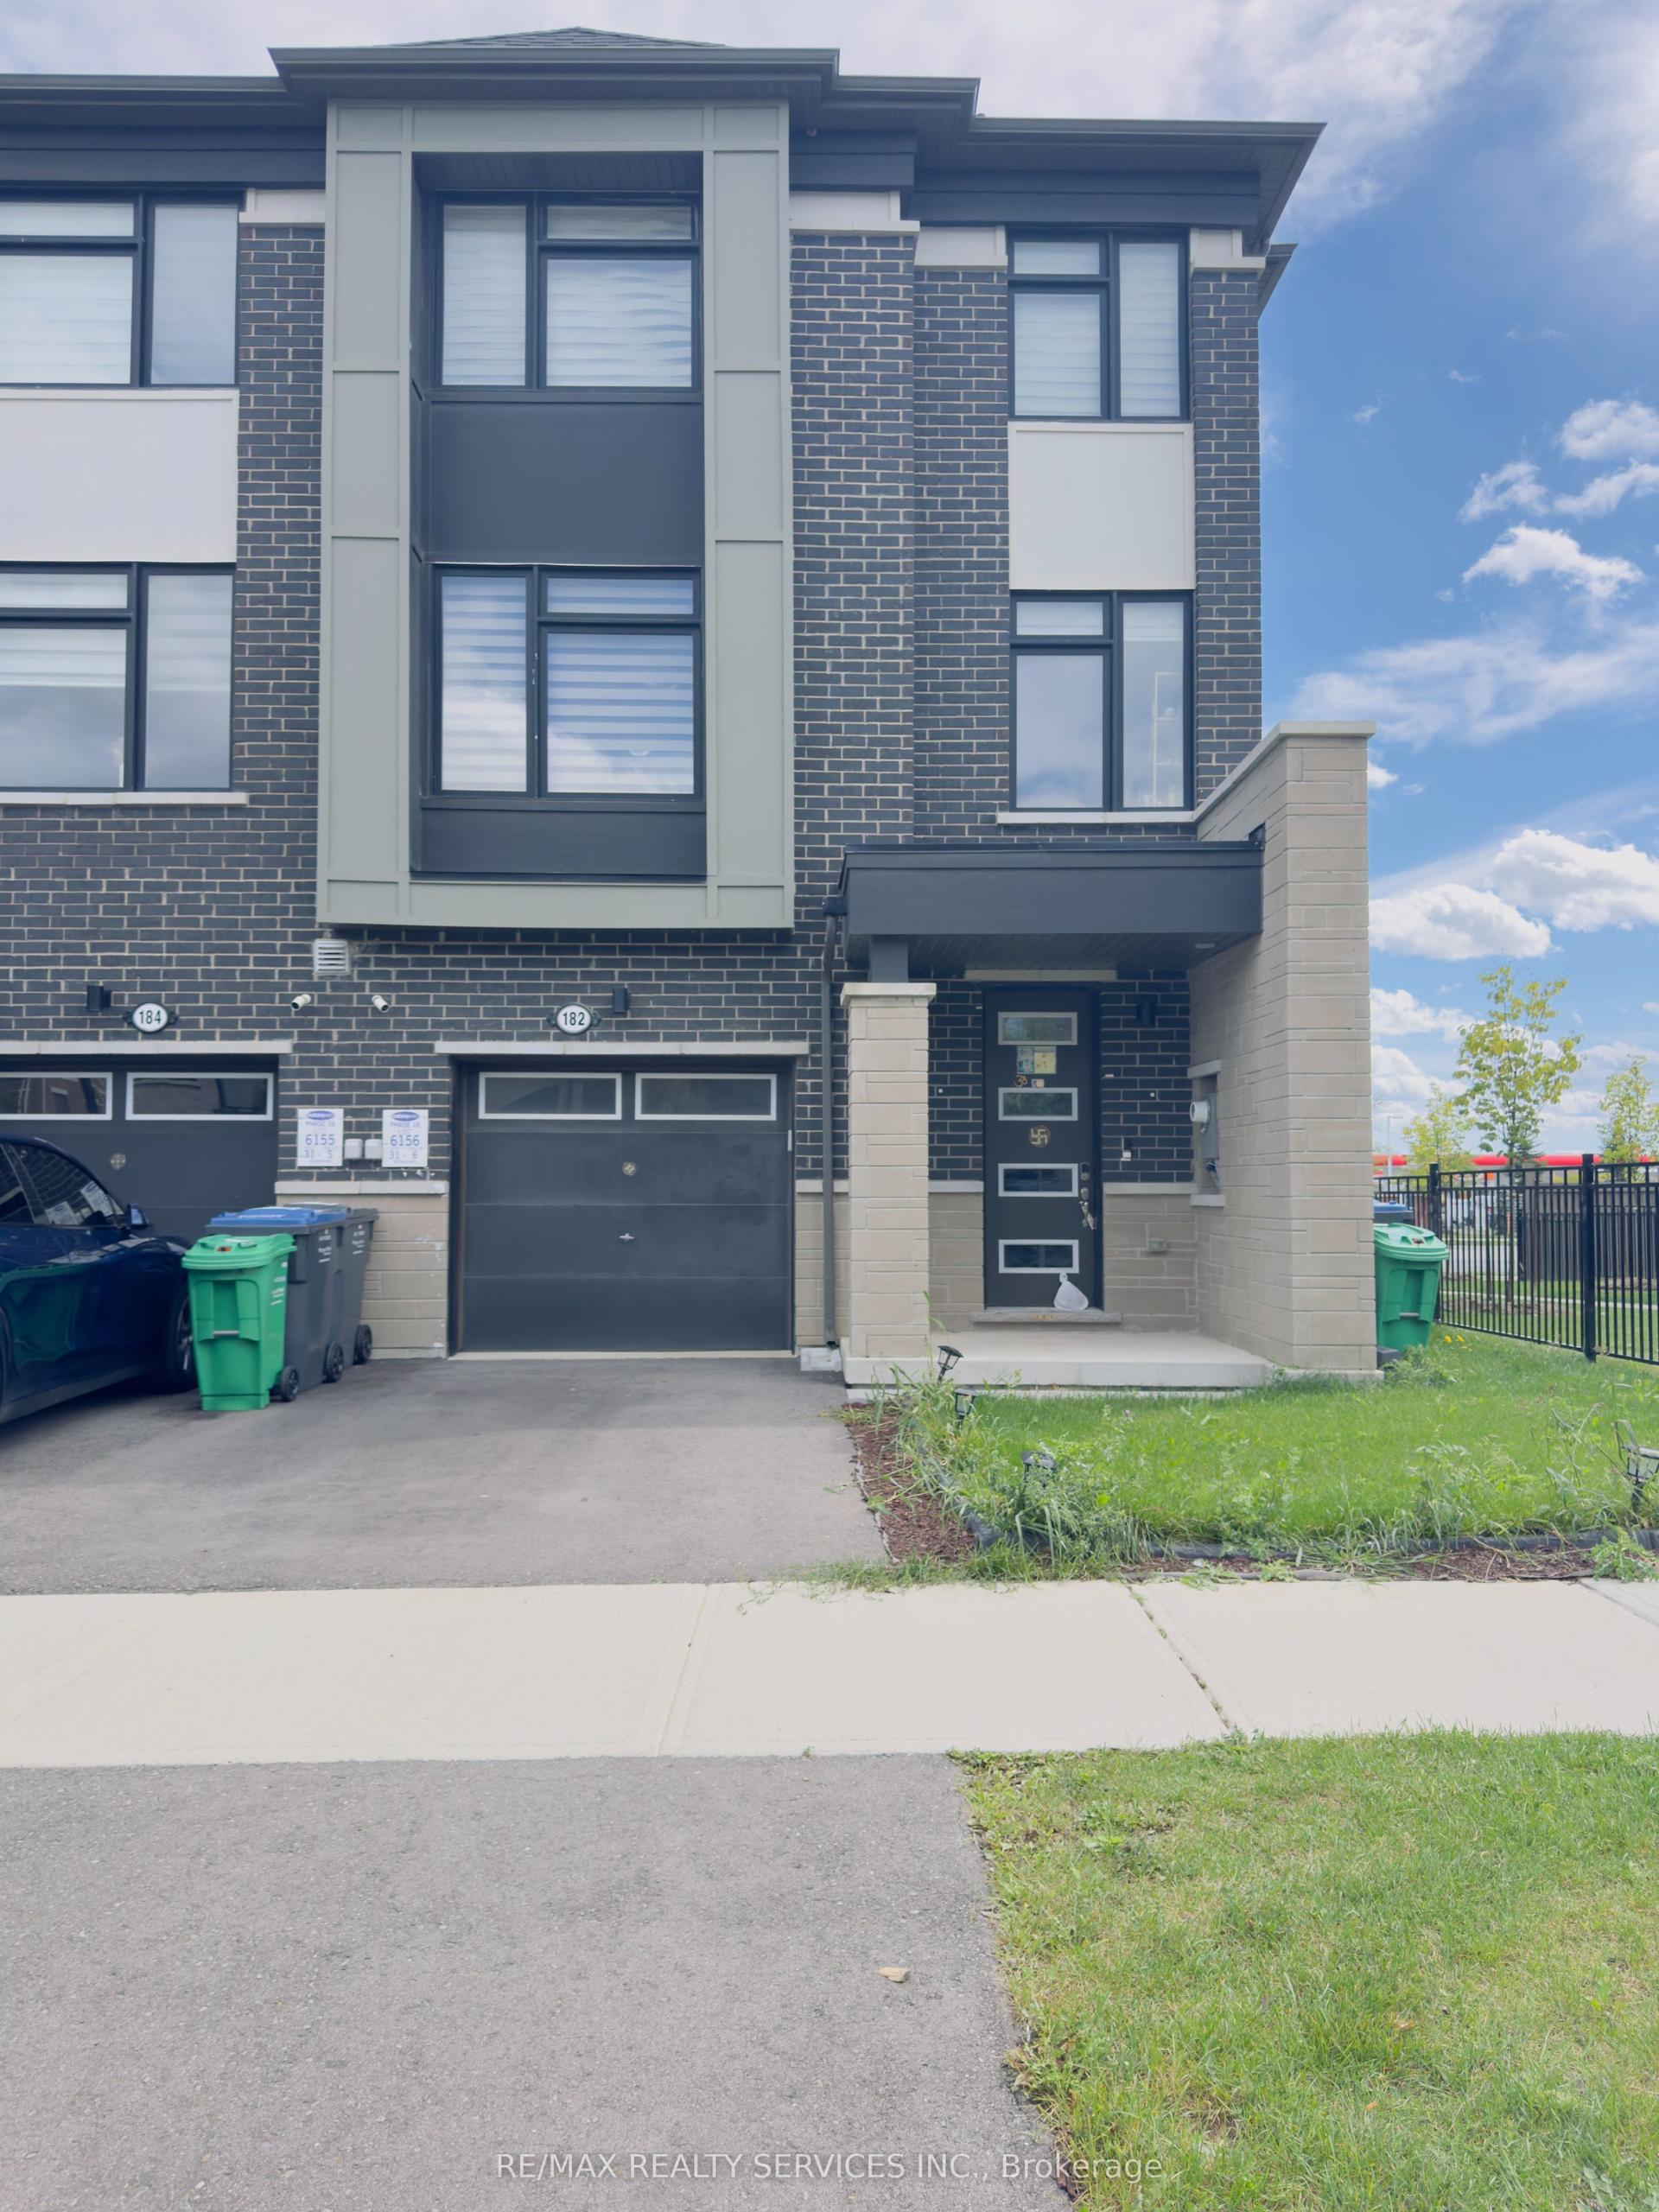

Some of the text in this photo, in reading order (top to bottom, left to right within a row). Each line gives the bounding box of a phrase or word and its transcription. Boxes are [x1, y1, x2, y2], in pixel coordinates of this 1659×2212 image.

[139, 1010, 161, 1024] 184
[563, 1012, 585, 1026] 182
[305, 1134, 335, 1145] 6155
[391, 1135, 420, 1146] 6156
